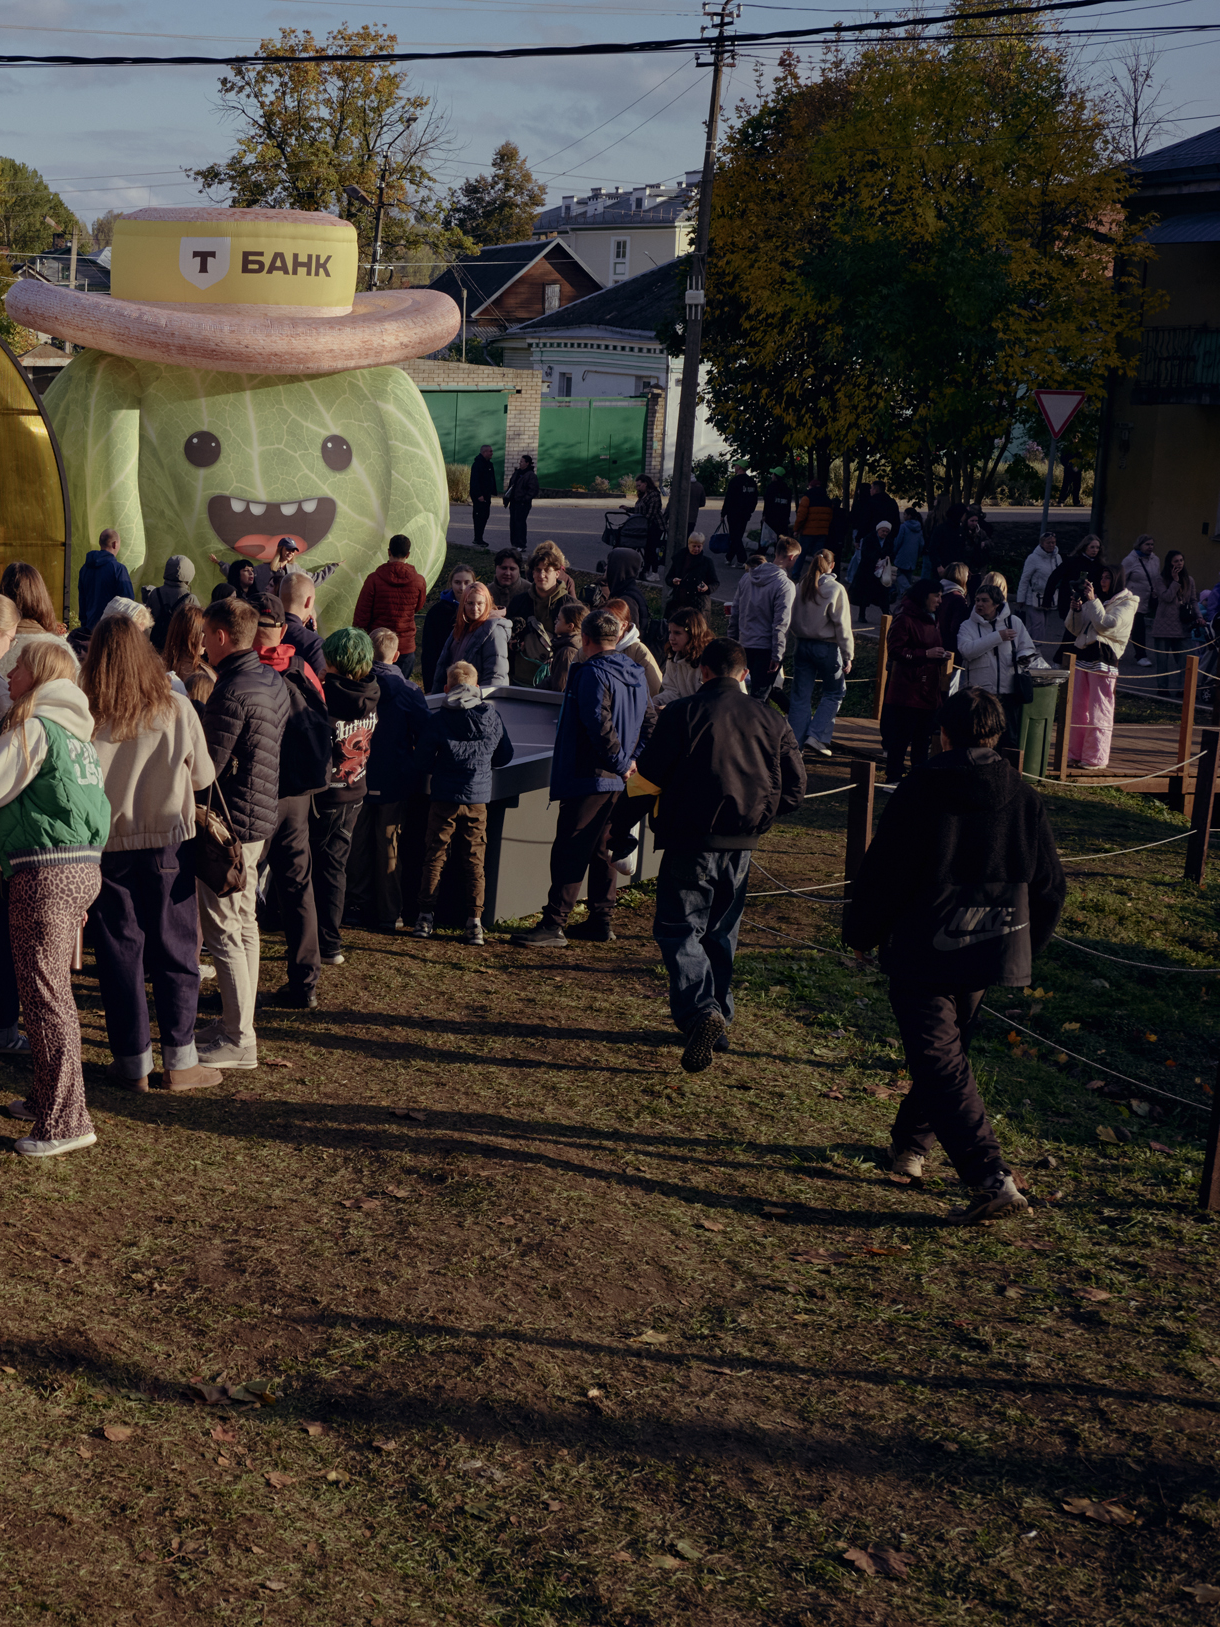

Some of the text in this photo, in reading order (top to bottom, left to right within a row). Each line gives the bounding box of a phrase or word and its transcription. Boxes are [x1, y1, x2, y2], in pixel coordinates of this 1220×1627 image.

[192, 250, 333, 278] Т БАНК
[948, 907, 1016, 930] NIKE
